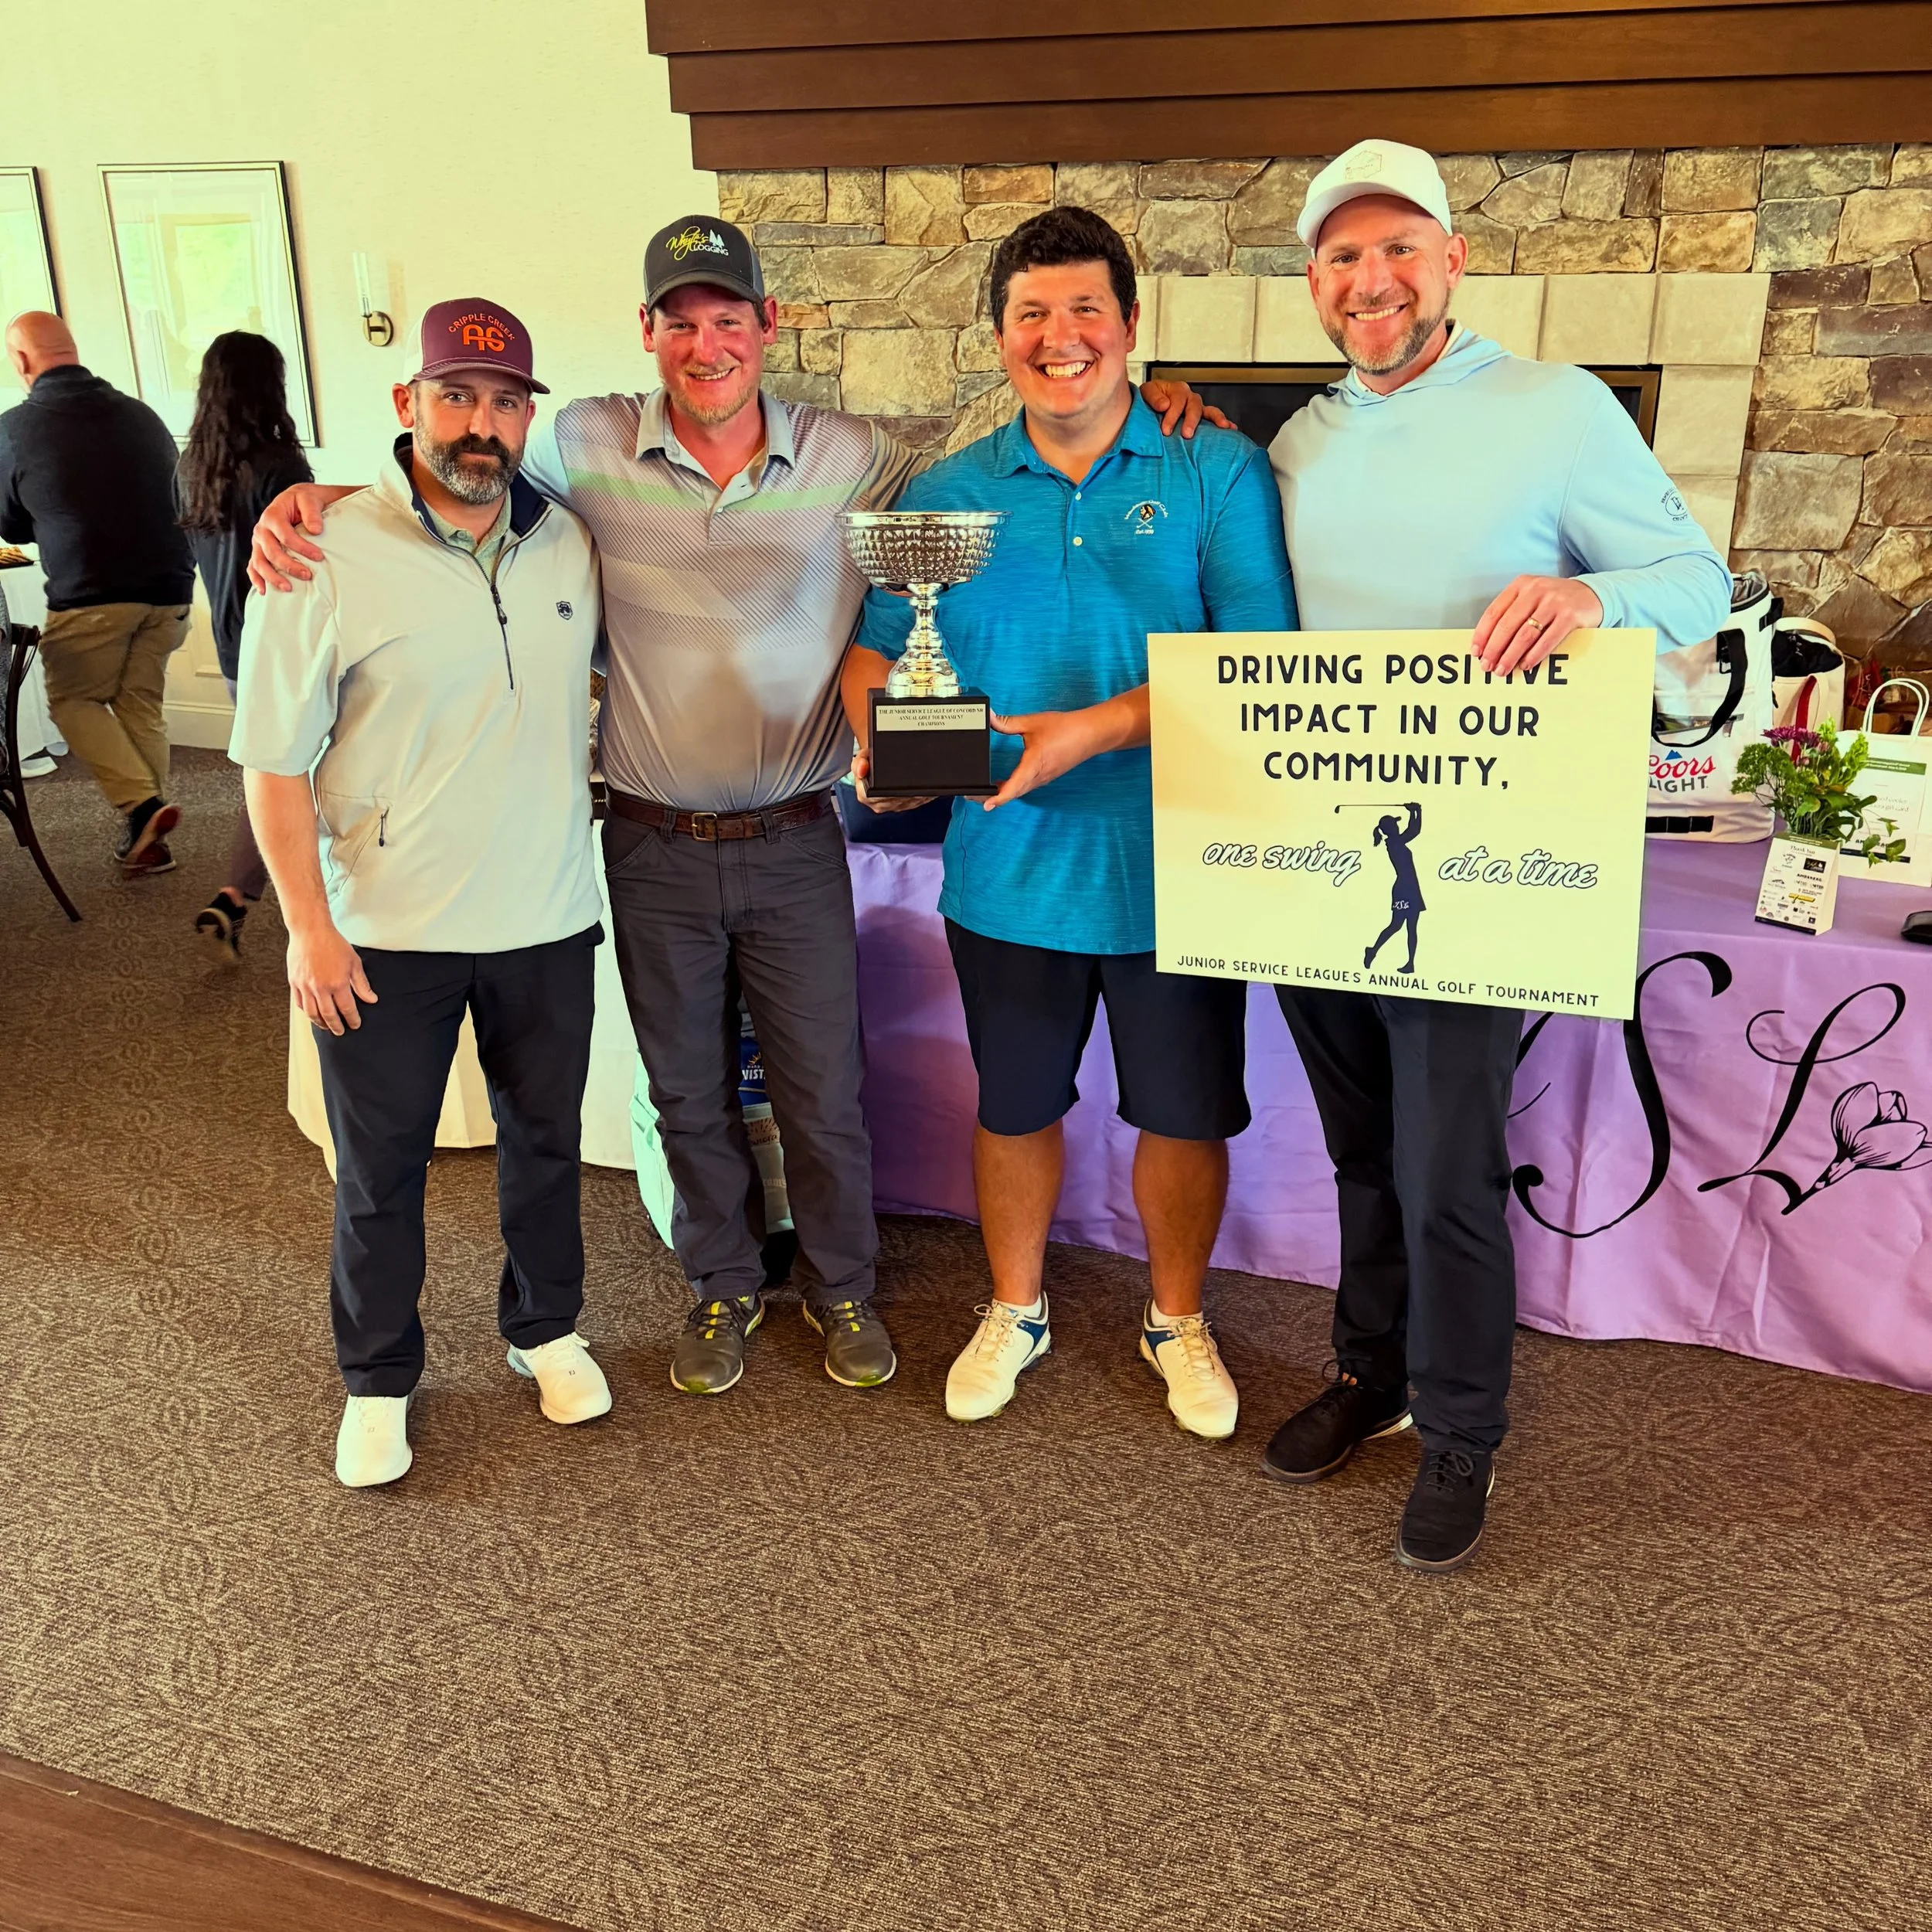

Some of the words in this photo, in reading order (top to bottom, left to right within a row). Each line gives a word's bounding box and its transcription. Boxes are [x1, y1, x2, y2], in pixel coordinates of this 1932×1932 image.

[690, 242, 730, 256] LOGGING
[448, 313, 486, 332] CRIPPLE
[488, 315, 515, 340] CREEK
[1218, 655, 1362, 684] DRIVING
[1241, 703, 1377, 733] IMPACT
[1400, 705, 1437, 734] IN
[1459, 706, 1539, 736] OUR
[1264, 751, 1509, 790] COMMUNITY,
[1648, 775, 1708, 793] LIGHT
[1202, 842, 1257, 868] one
[1261, 840, 1362, 887] swing
[1438, 845, 1489, 883] at
[1481, 859, 1513, 884] a
[1516, 849, 1599, 889] time
[1177, 955, 1226, 971] JUNIOR
[1233, 960, 1289, 977] SERVICE
[1369, 974, 1430, 991] ANNUAL
[1437, 981, 1477, 995] GOLF
[1486, 985, 1600, 1007] TOURNAMENT
[742, 1069, 766, 1081] VIST
